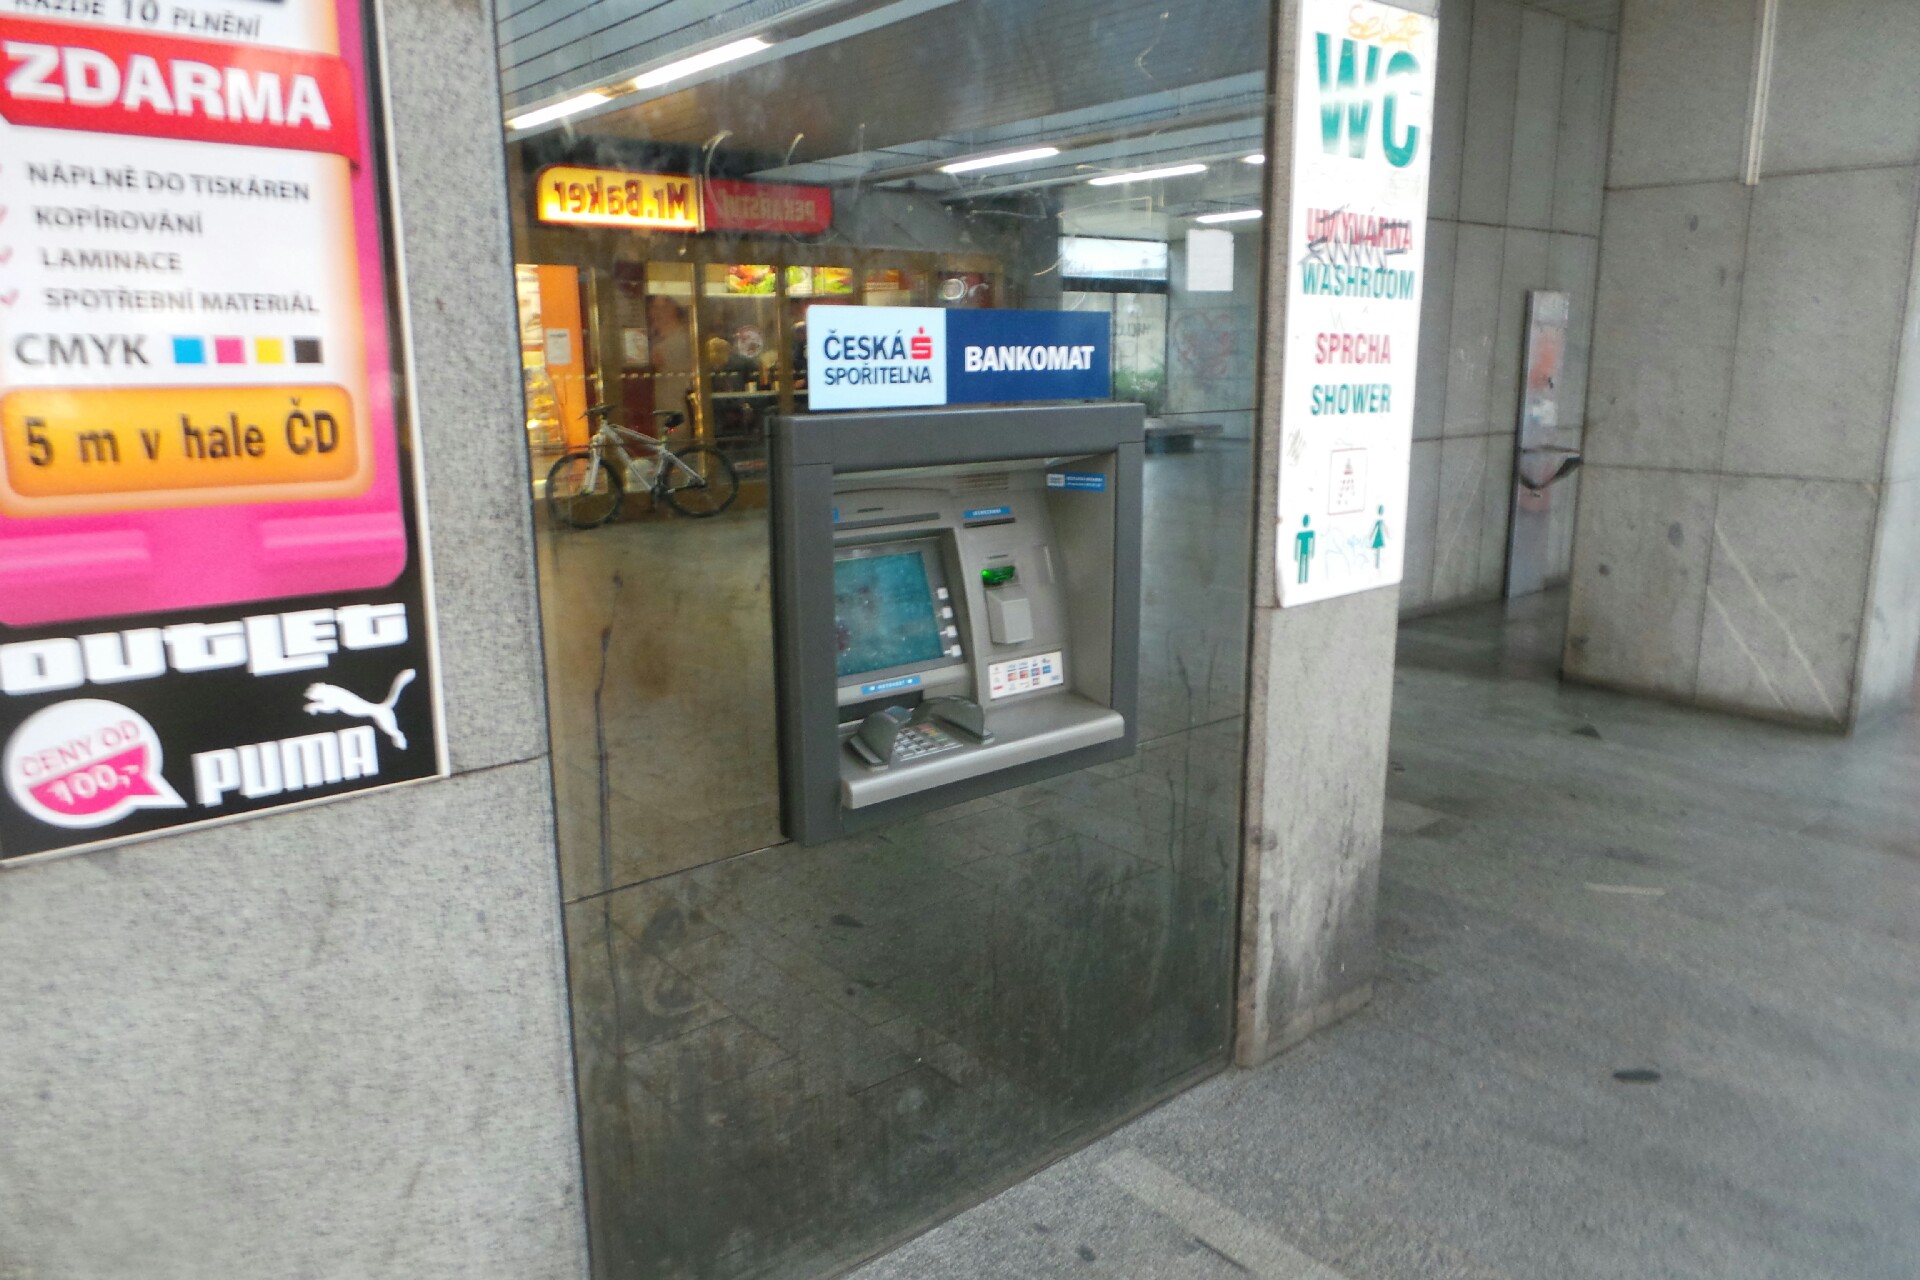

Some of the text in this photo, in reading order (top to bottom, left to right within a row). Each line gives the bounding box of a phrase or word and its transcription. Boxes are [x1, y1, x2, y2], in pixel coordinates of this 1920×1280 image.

[124, 0, 160, 23] 10
[173, 8, 261, 37] PLNĚNÍ
[3, 40, 332, 130] ZDARMA
[1315, 31, 1422, 168] WC
[28, 160, 311, 201] NÁPLNĚ DO TISKÁREN
[34, 205, 204, 235] KOPÍROVÁNÍ
[42, 247, 183, 271] LAMINACE
[1302, 262, 1415, 300] WASHROOM
[46, 287, 320, 314] SPOTŘEBNÍ MATERIÁL
[14, 333, 150, 366] CMYK
[824, 328, 906, 360] ČESKÁ
[964, 345, 1095, 373] BANKOMAT
[1315, 332, 1391, 364] SPRCHA
[825, 362, 933, 386] SPOŘITELNA
[1310, 383, 1392, 416] SHOWER
[26, 397, 339, 466] 5 m v hale ČD
[21, 720, 141, 776] CENY OD
[192, 725, 379, 807] PUMA
